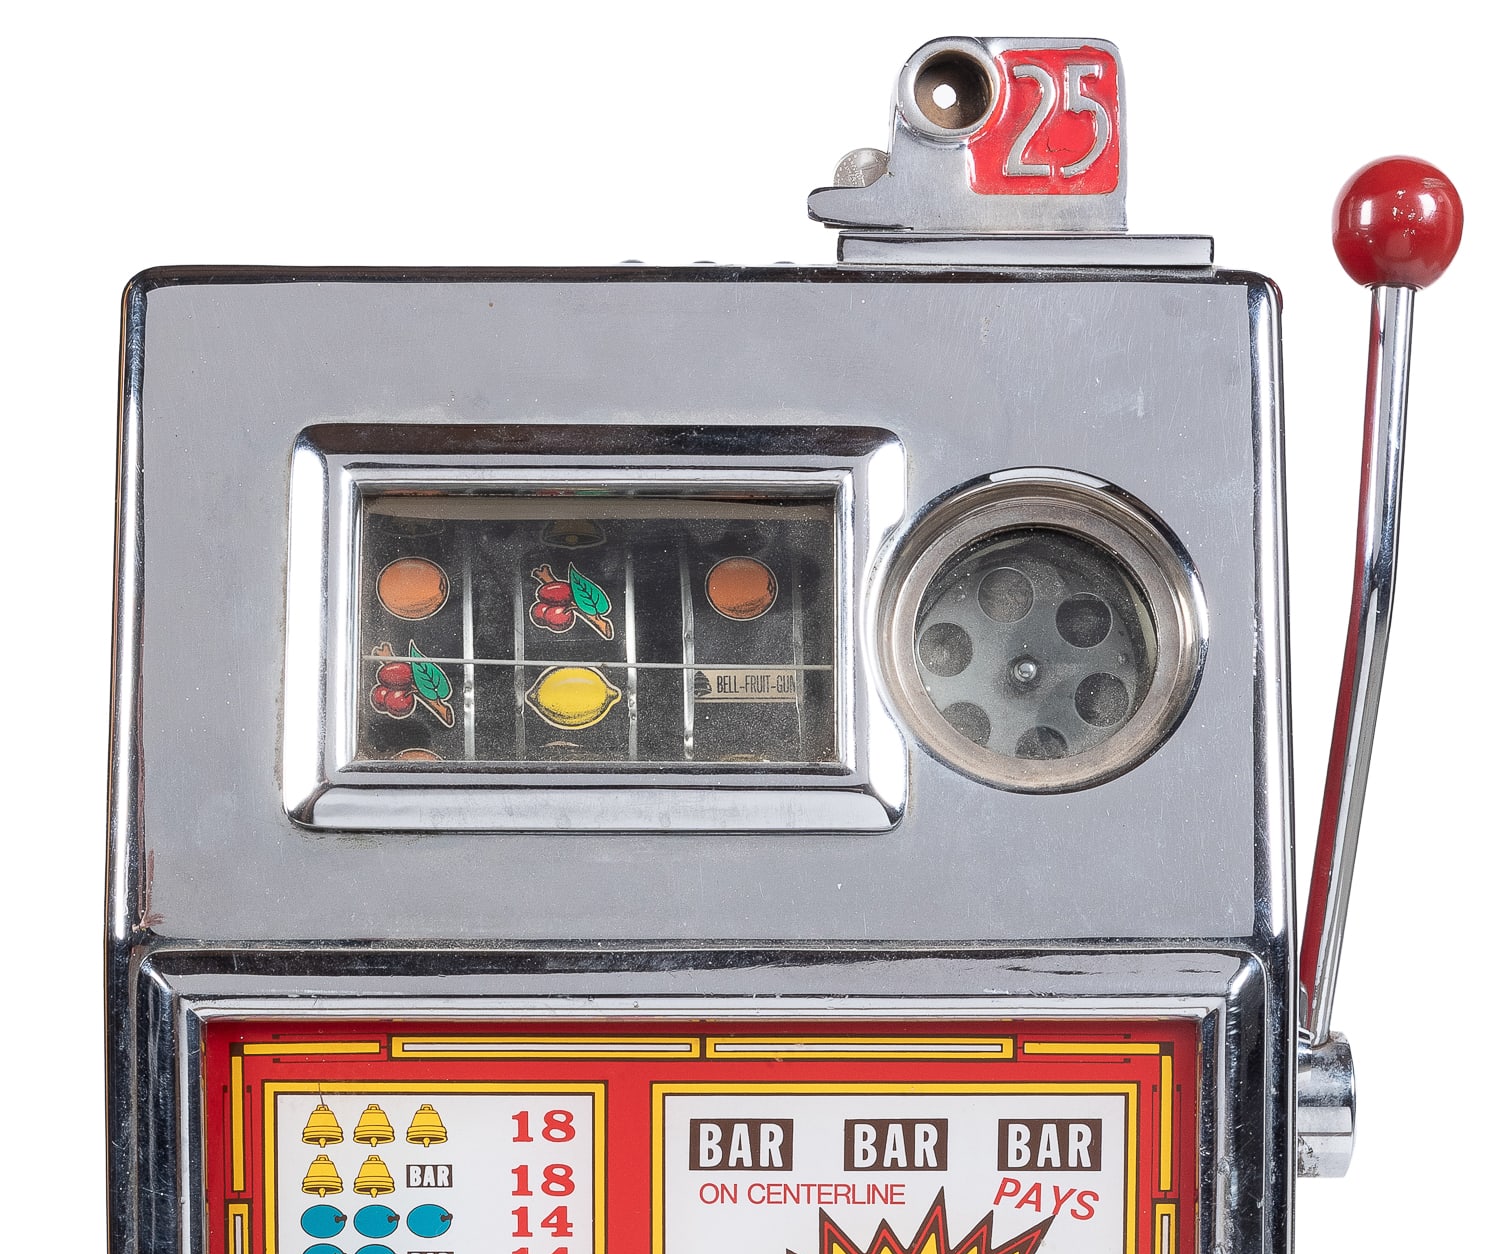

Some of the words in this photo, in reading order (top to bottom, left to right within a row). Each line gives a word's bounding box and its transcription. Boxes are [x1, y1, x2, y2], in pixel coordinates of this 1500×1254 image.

[1003, 63, 1112, 178] 25
[511, 1110, 576, 1143] 18
[699, 1123, 784, 1168] BAR
[853, 1123, 938, 1168] BAR
[1007, 1123, 1092, 1168] BAR
[409, 1165, 450, 1187] BAR
[511, 1163, 576, 1197] 18
[699, 1182, 739, 1205] ON
[746, 1182, 906, 1205] CENTERLINE
[993, 1177, 1100, 1221] PAYS
[511, 1205, 574, 1238] 14
